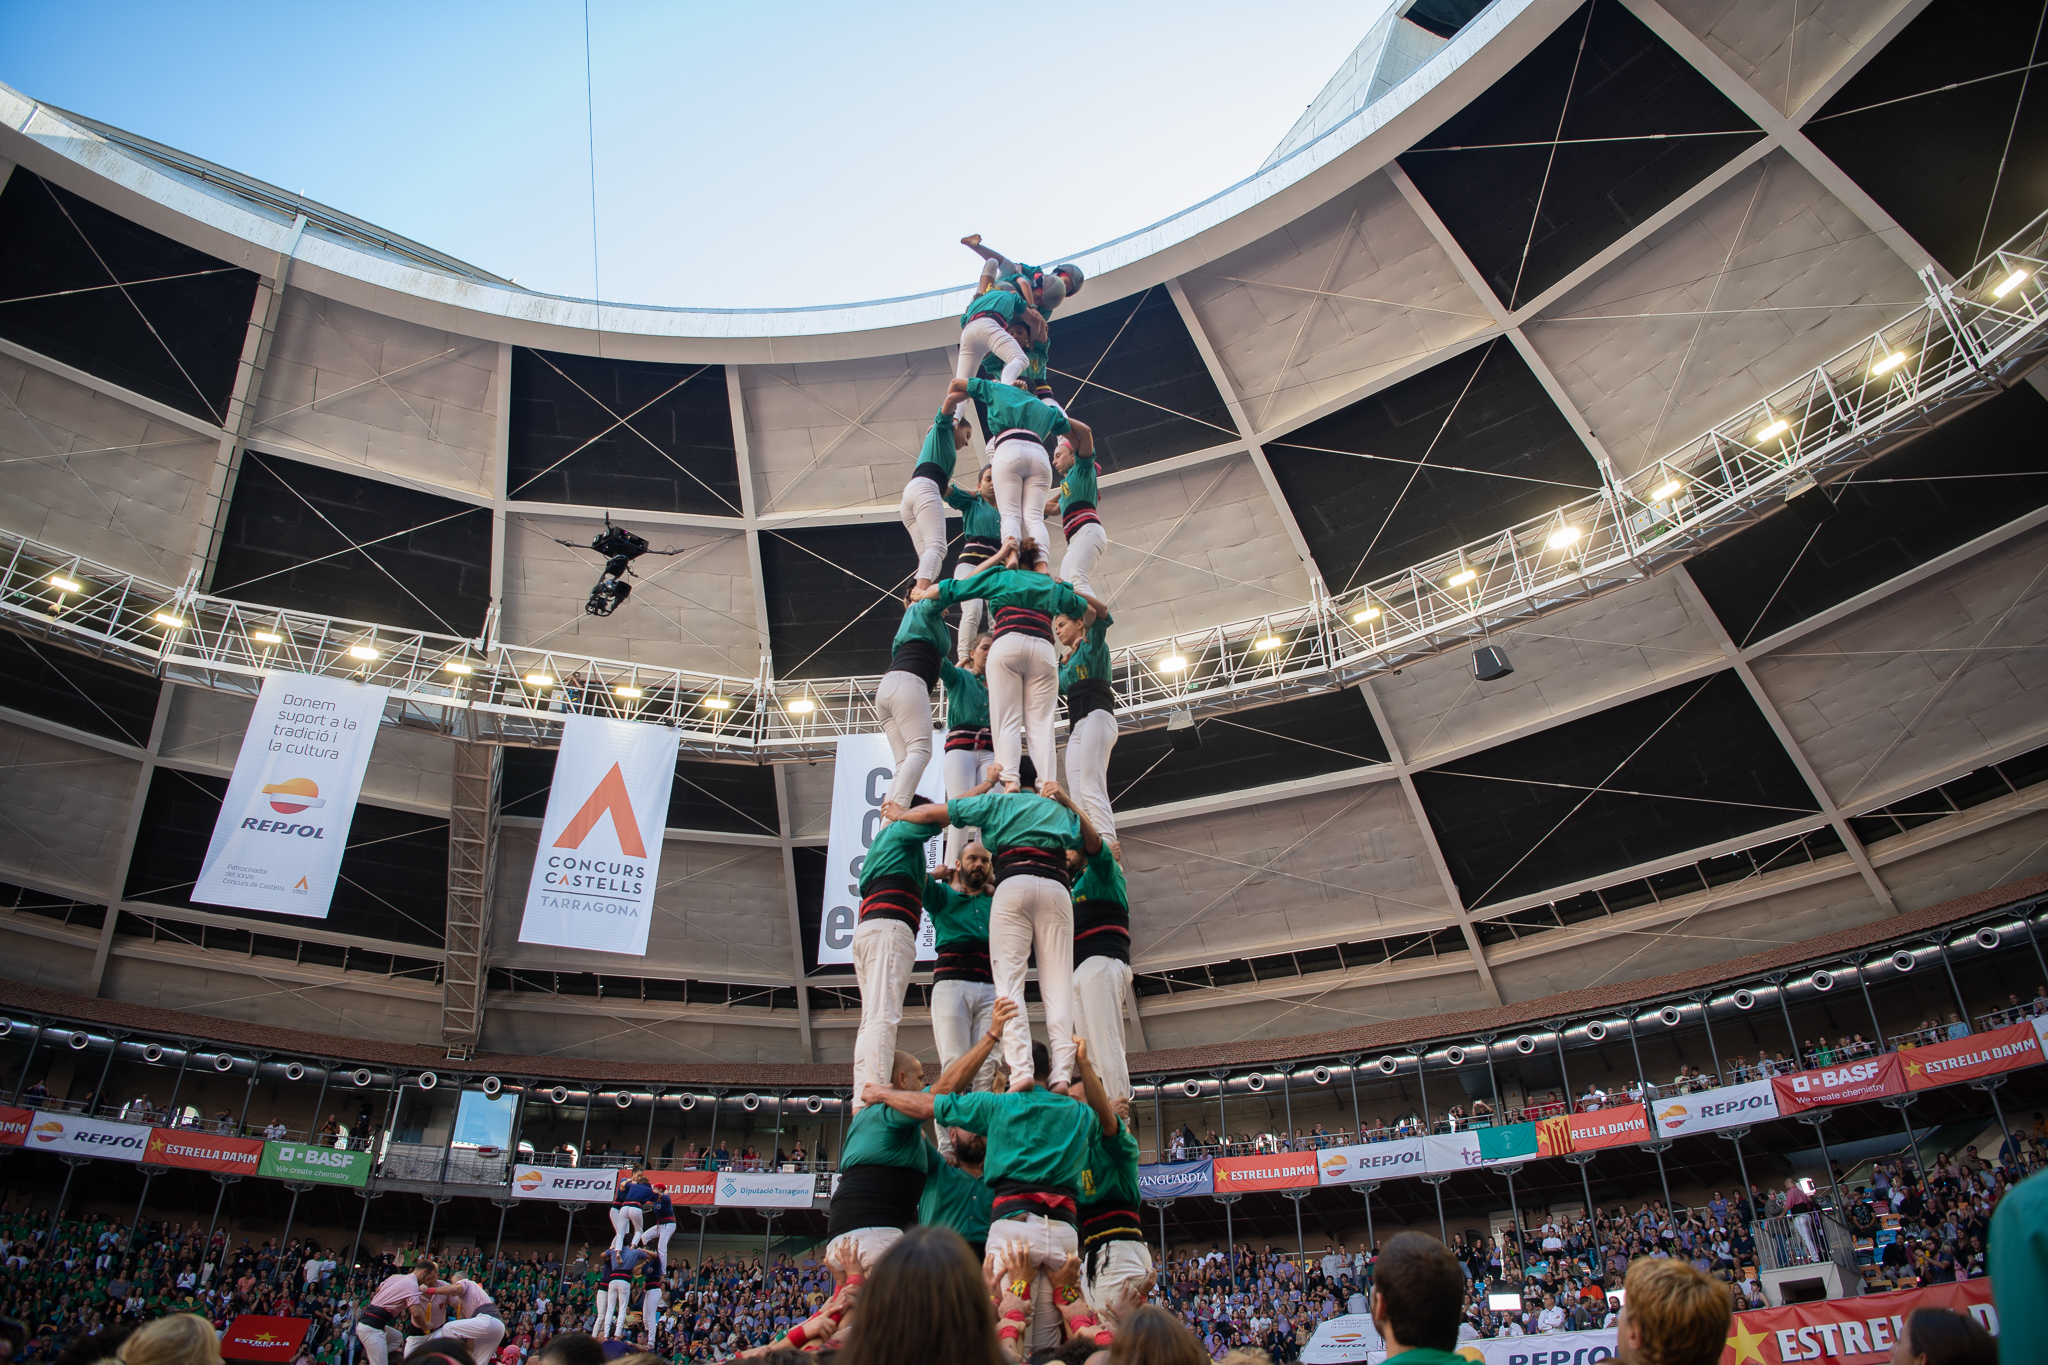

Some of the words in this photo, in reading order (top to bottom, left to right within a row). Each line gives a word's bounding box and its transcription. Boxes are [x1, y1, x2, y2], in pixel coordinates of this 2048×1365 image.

[283, 694, 336, 711] Donem
[278, 711, 326, 726] suport
[330, 718, 339, 727] a
[343, 718, 357, 731] la
[273, 724, 329, 742] tradició
[333, 732, 338, 743] i
[268, 739, 282, 752] la
[285, 744, 339, 760] cultura
[240, 817, 324, 839] REPSOL
[227, 864, 269, 875] Patrocinador
[548, 856, 645, 879] CONCURS
[222, 878, 249, 887] Concurs
[259, 883, 285, 892] Castells
[545, 872, 642, 894] CASTELLS
[541, 895, 638, 917] TARRAGONA
[1924, 1050, 1991, 1074] ESTRELLA
[1992, 1038, 2037, 1060] DAMM
[1821, 1061, 1879, 1088] BASF
[1812, 1093, 1841, 1102] create
[1842, 1084, 1885, 1098] chemistry
[1701, 1095, 1772, 1118] REPSOL
[1571, 1125, 1607, 1141] RELLA
[1608, 1118, 1646, 1134] DAMM
[73, 1131, 144, 1149] REPSOL
[165, 1144, 220, 1160] ESTRELLA
[221, 1151, 258, 1164] DAMM
[304, 1149, 355, 1168] BASF
[1359, 1151, 1423, 1169] REPSOL
[276, 1165, 288, 1173] We
[289, 1167, 313, 1175] create
[314, 1170, 350, 1181] chemistry
[1231, 1168, 1281, 1181] ESTRELLA
[1282, 1165, 1316, 1177] DAMM
[552, 1178, 613, 1191] REPSOL
[682, 1184, 714, 1194] DAMM
[740, 1187, 774, 1196] Diputació
[775, 1187, 809, 1197] Tarragona
[234, 1338, 289, 1346] ESTRELLA
[1775, 1314, 1904, 1363] ESTRE
[1508, 1346, 1620, 1365] REPSO
